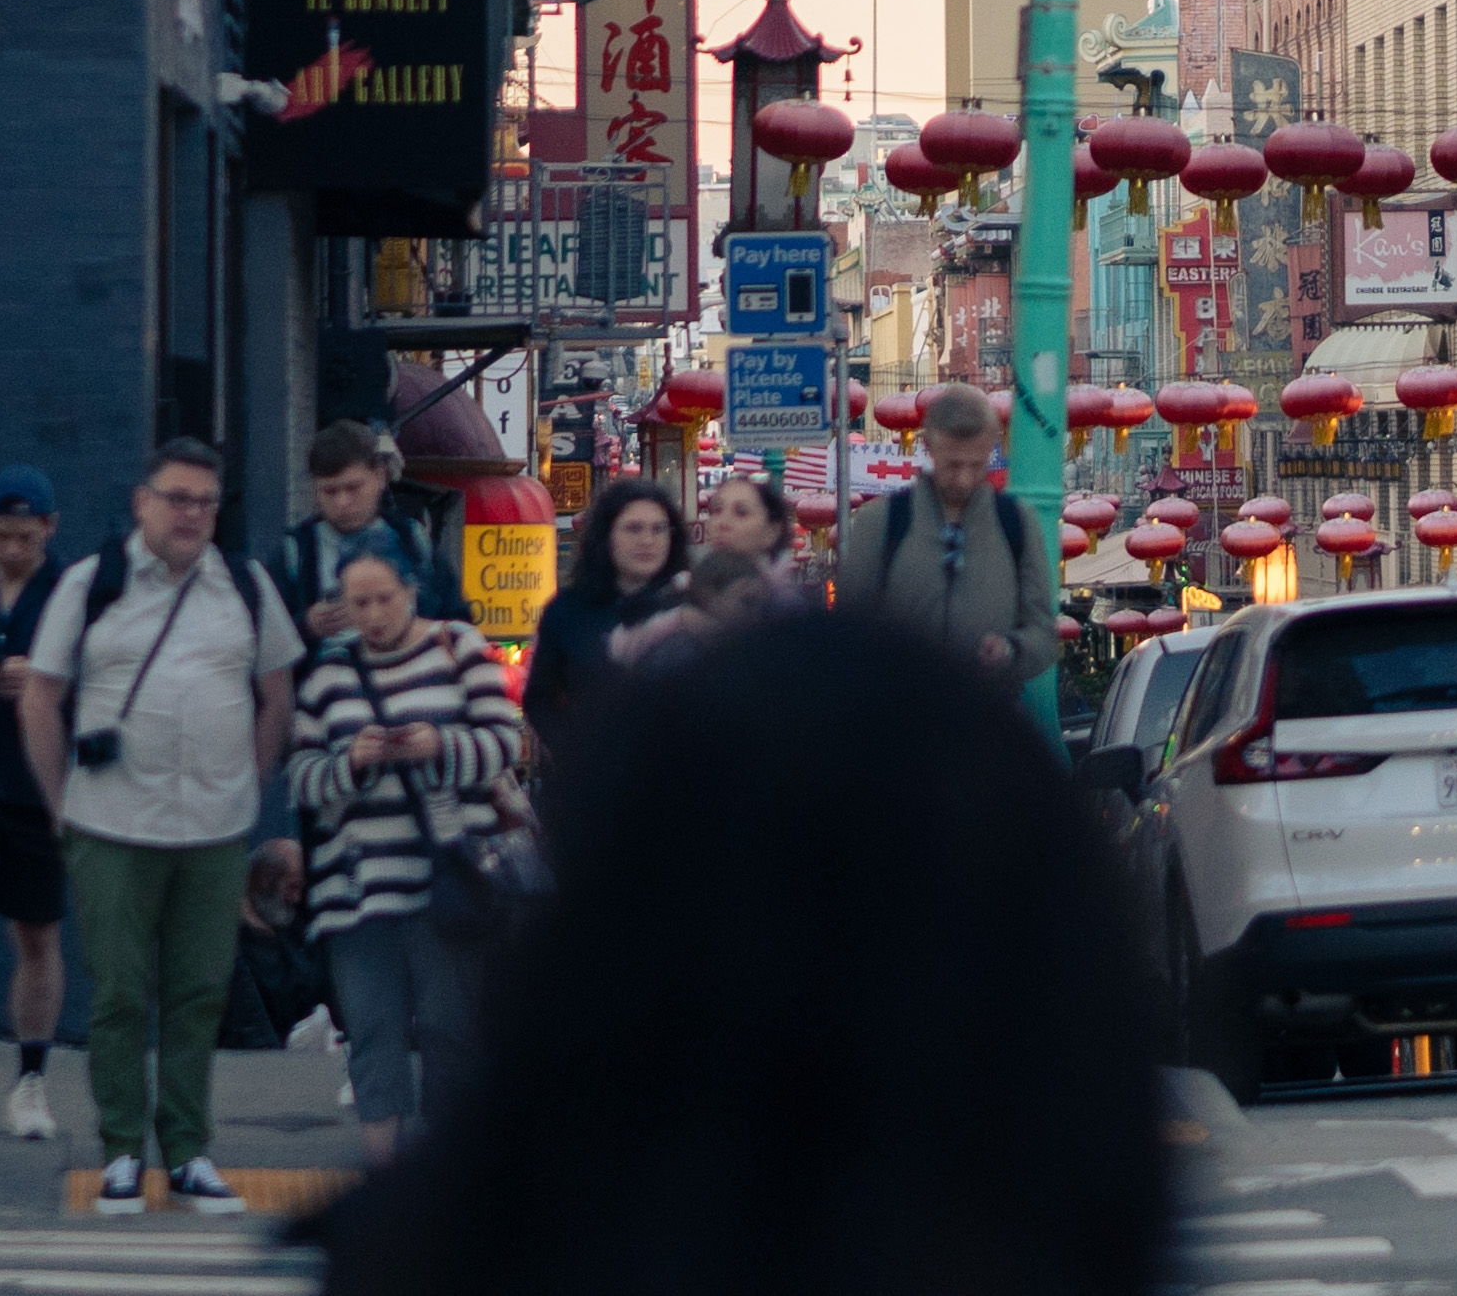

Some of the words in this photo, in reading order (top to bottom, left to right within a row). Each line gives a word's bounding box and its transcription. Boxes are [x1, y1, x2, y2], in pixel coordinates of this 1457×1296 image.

[354, 64, 464, 104] GALLERY
[480, 233, 672, 264] SEAFD
[1353, 217, 1425, 269] Kan's
[733, 246, 772, 269] Pay
[773, 245, 821, 263] here
[476, 272, 681, 299] RESTANT
[1298, 270, 1323, 367] 冠園
[733, 352, 768, 371] Pay
[773, 349, 797, 371] by
[733, 370, 803, 387] License
[733, 388, 782, 406] Plate
[737, 411, 820, 427] 44406003
[478, 528, 546, 557] Chinese
[521, 599, 545, 625] Su
